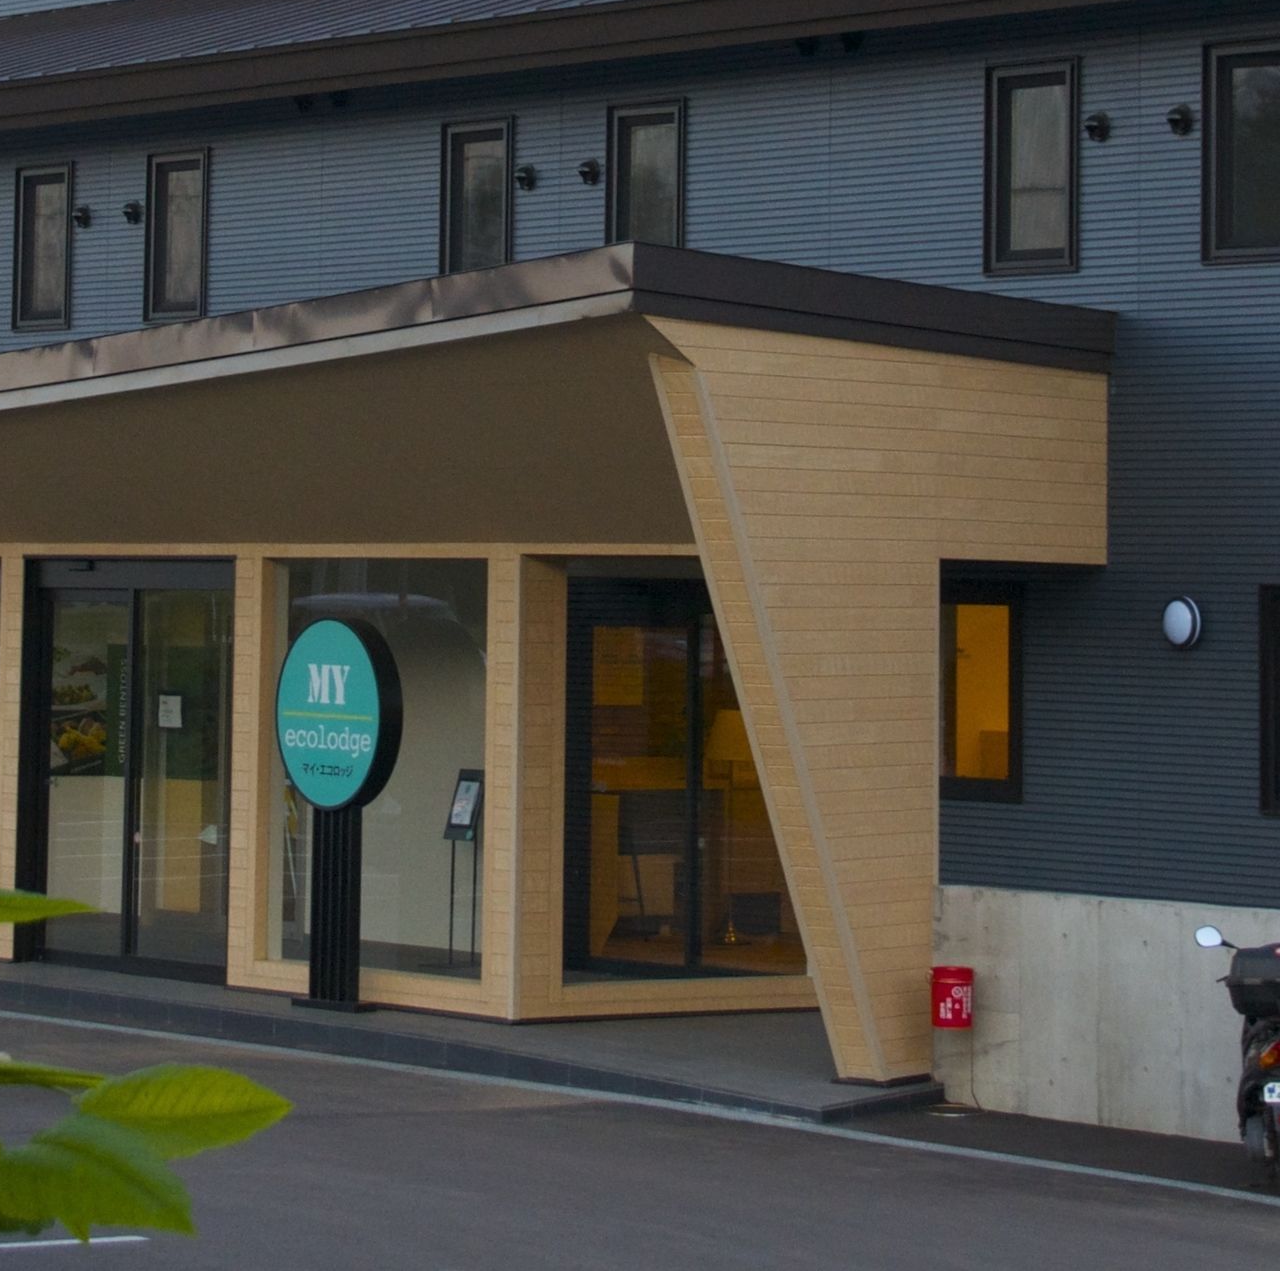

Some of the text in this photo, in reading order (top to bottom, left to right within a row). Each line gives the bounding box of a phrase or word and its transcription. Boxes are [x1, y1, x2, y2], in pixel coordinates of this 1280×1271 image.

[307, 663, 351, 705] MY
[118, 721, 127, 764] GREEN
[285, 725, 371, 758] ecolodge
[302, 763, 354, 777] マイ・エコロッジ
